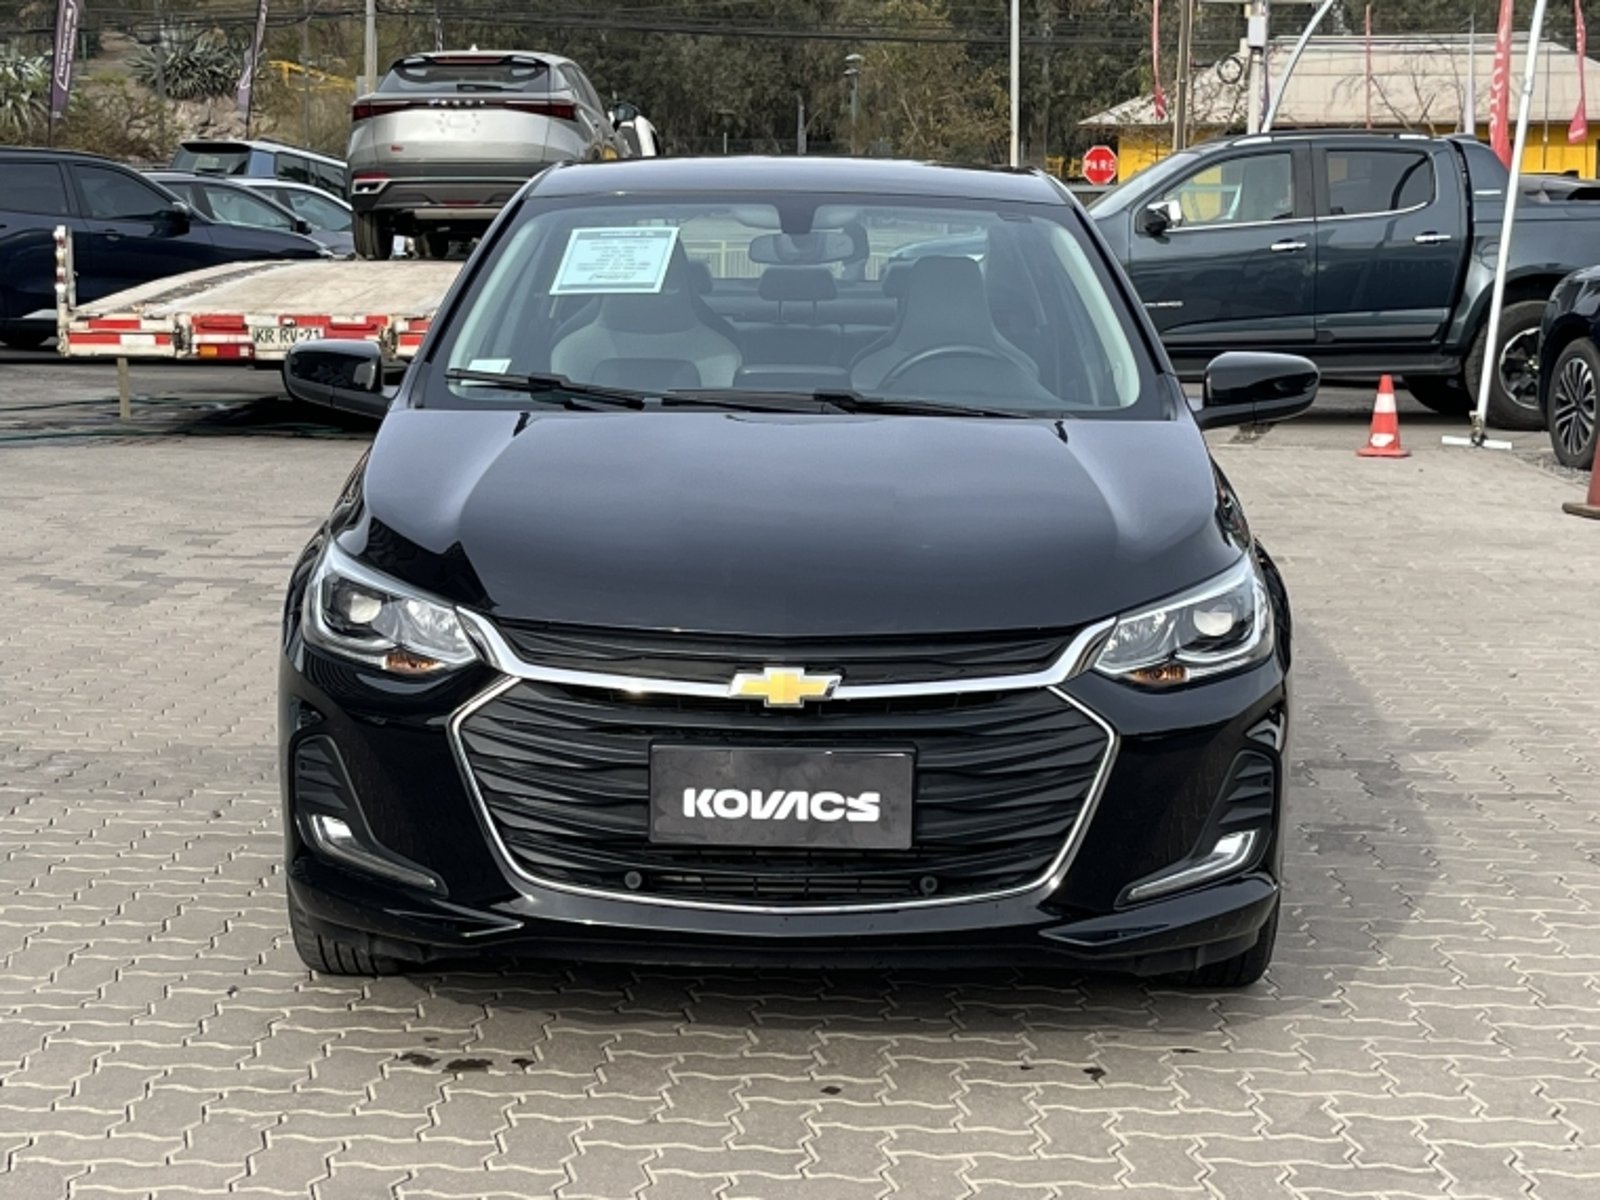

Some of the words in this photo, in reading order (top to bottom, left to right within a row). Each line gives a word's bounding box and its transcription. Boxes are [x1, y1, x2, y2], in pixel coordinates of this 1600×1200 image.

[1084, 159, 1114, 171] PARE
[254, 328, 274, 343] KR
[683, 788, 880, 822] KOVACS
